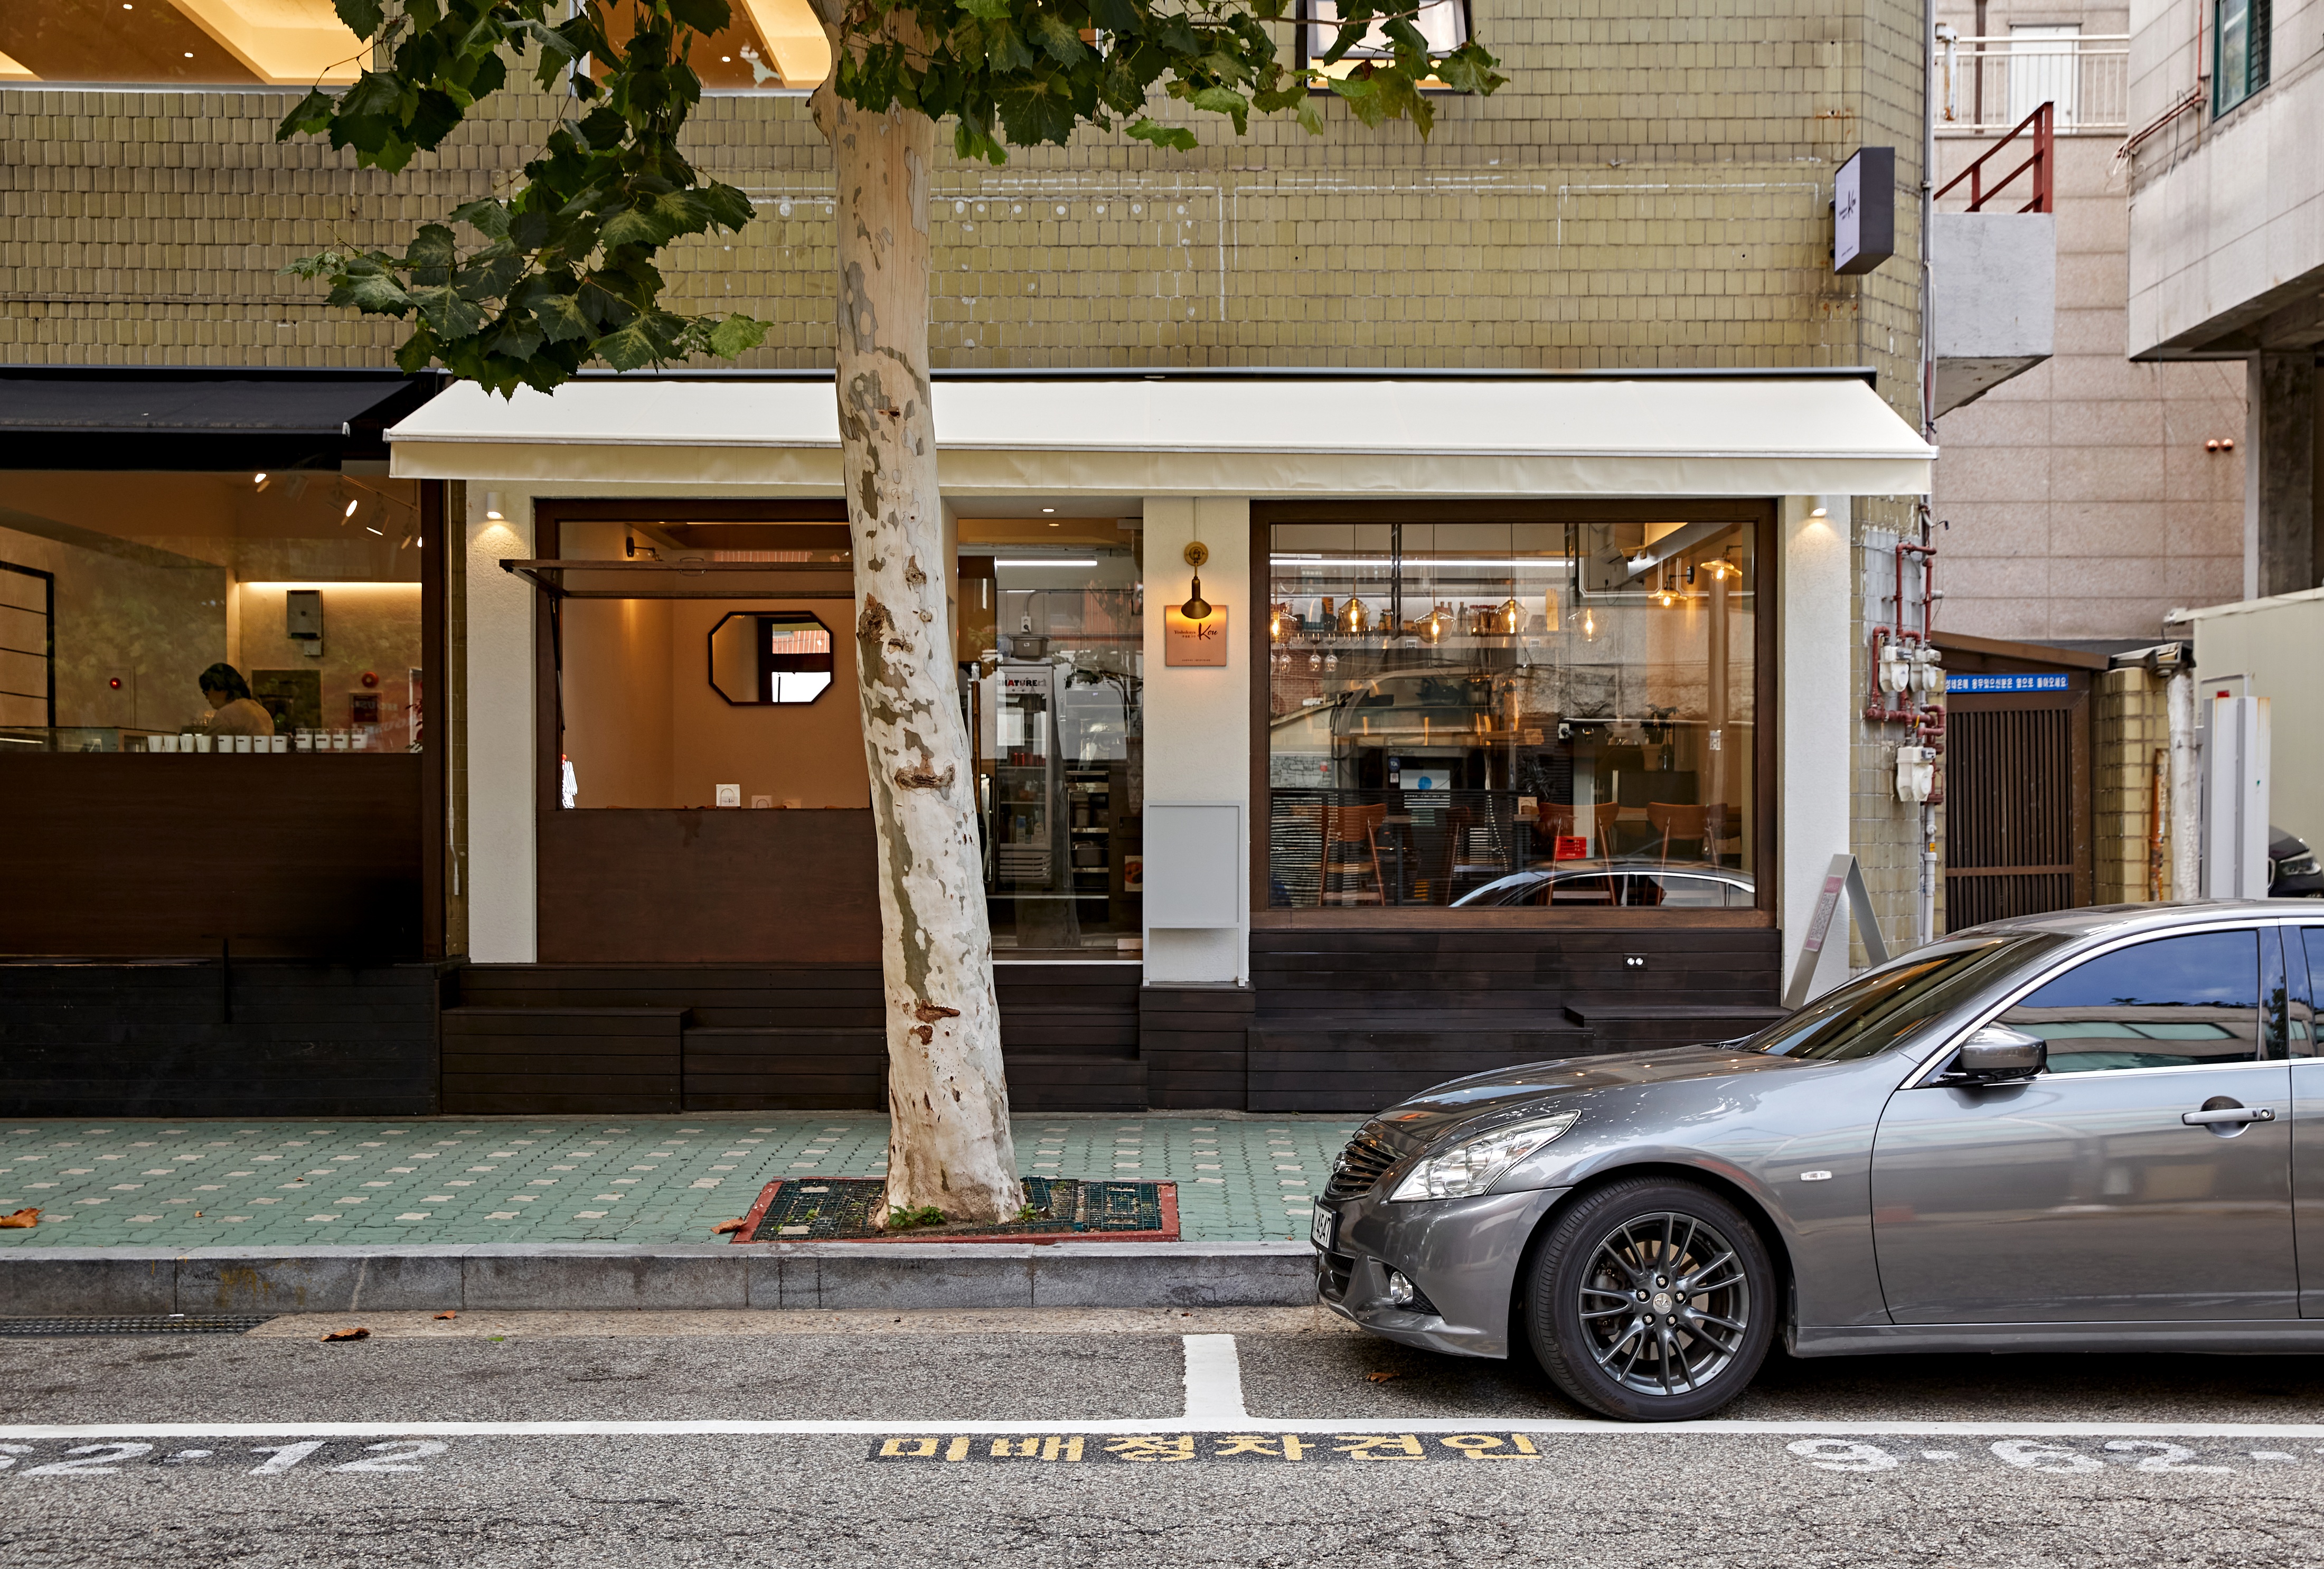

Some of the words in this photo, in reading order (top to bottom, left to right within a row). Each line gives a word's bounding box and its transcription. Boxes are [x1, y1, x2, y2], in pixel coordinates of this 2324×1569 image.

[1198, 622, 1218, 641] Kou
[1317, 1213, 1331, 1243] 4547
[1786, 1438, 2324, 1475] 9-62-
